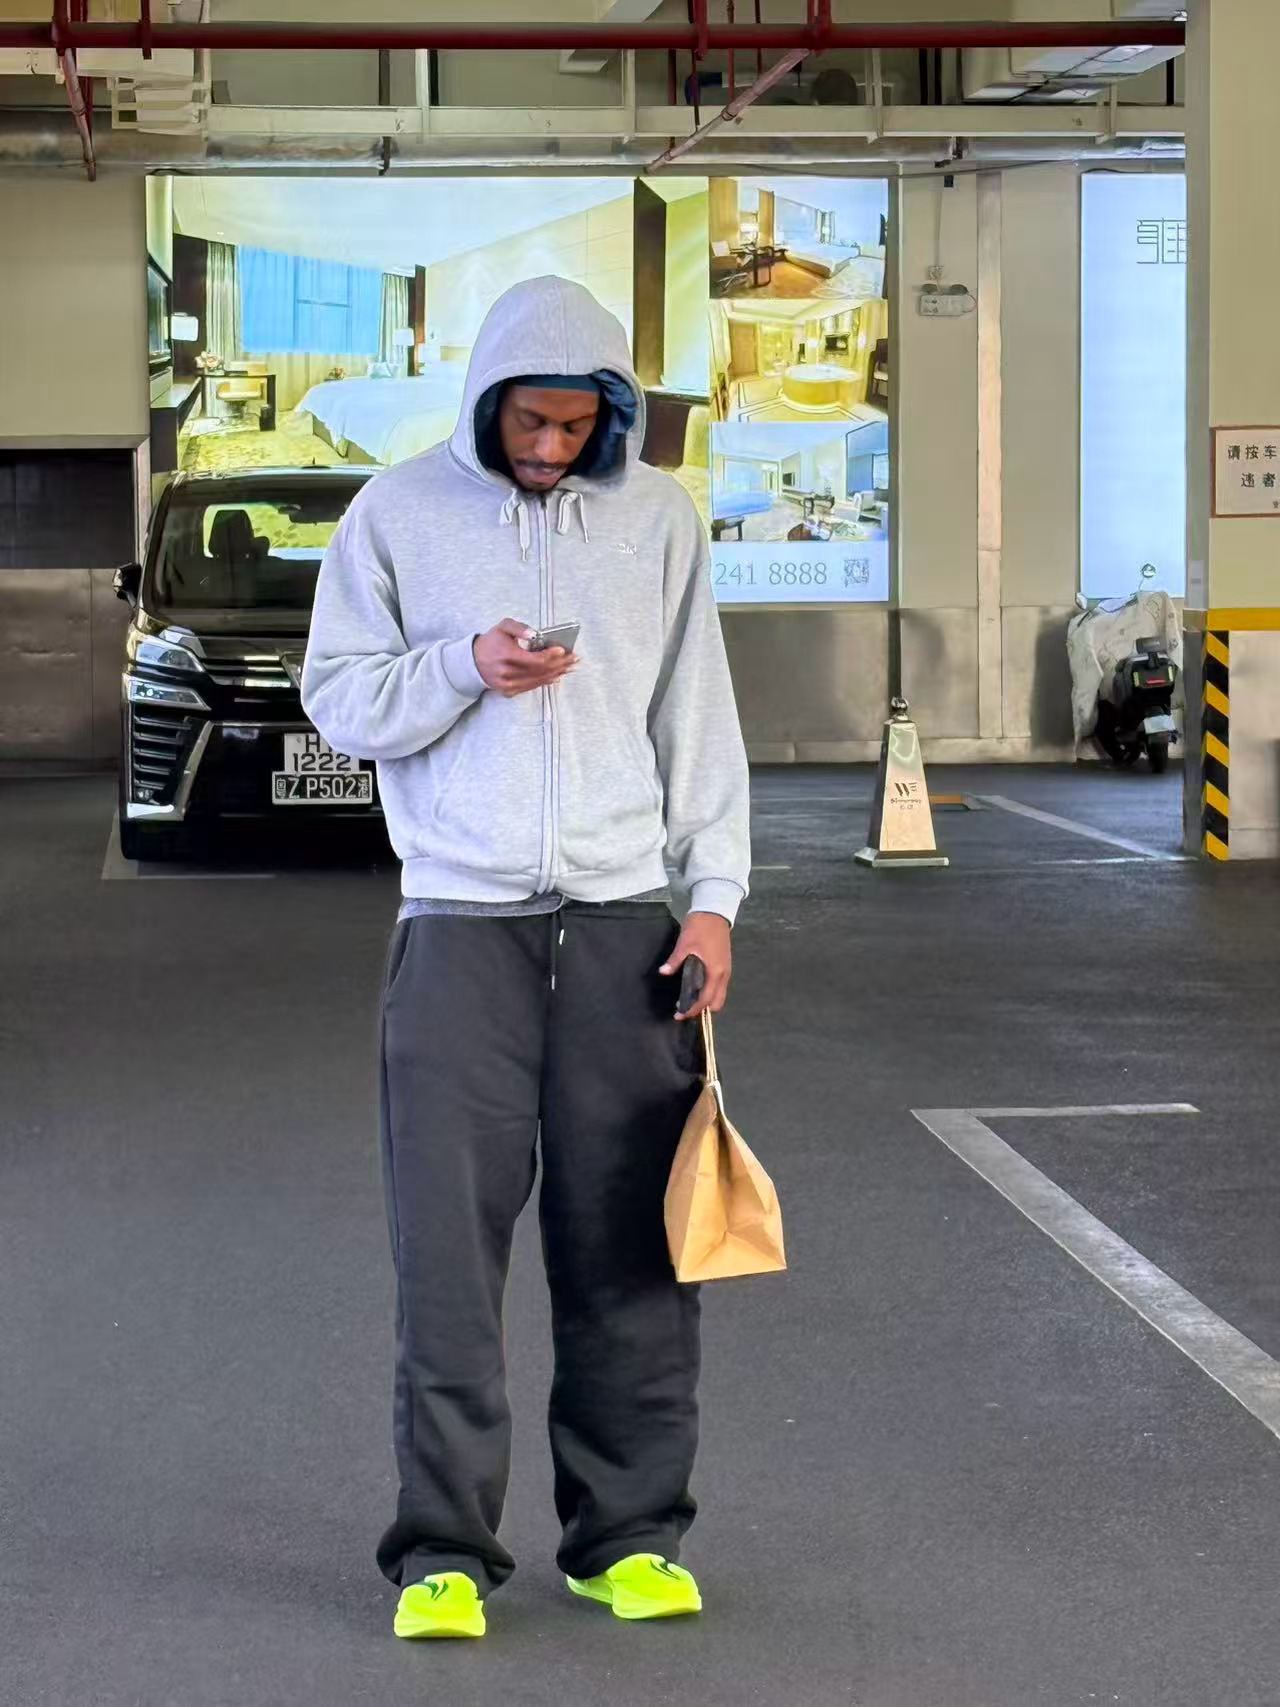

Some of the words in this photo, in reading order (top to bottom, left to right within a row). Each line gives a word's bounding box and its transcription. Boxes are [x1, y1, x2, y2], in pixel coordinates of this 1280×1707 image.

[715, 562, 757, 586] 241
[768, 562, 828, 586] 8888
[305, 734, 333, 753] H
[293, 752, 351, 772] 1222
